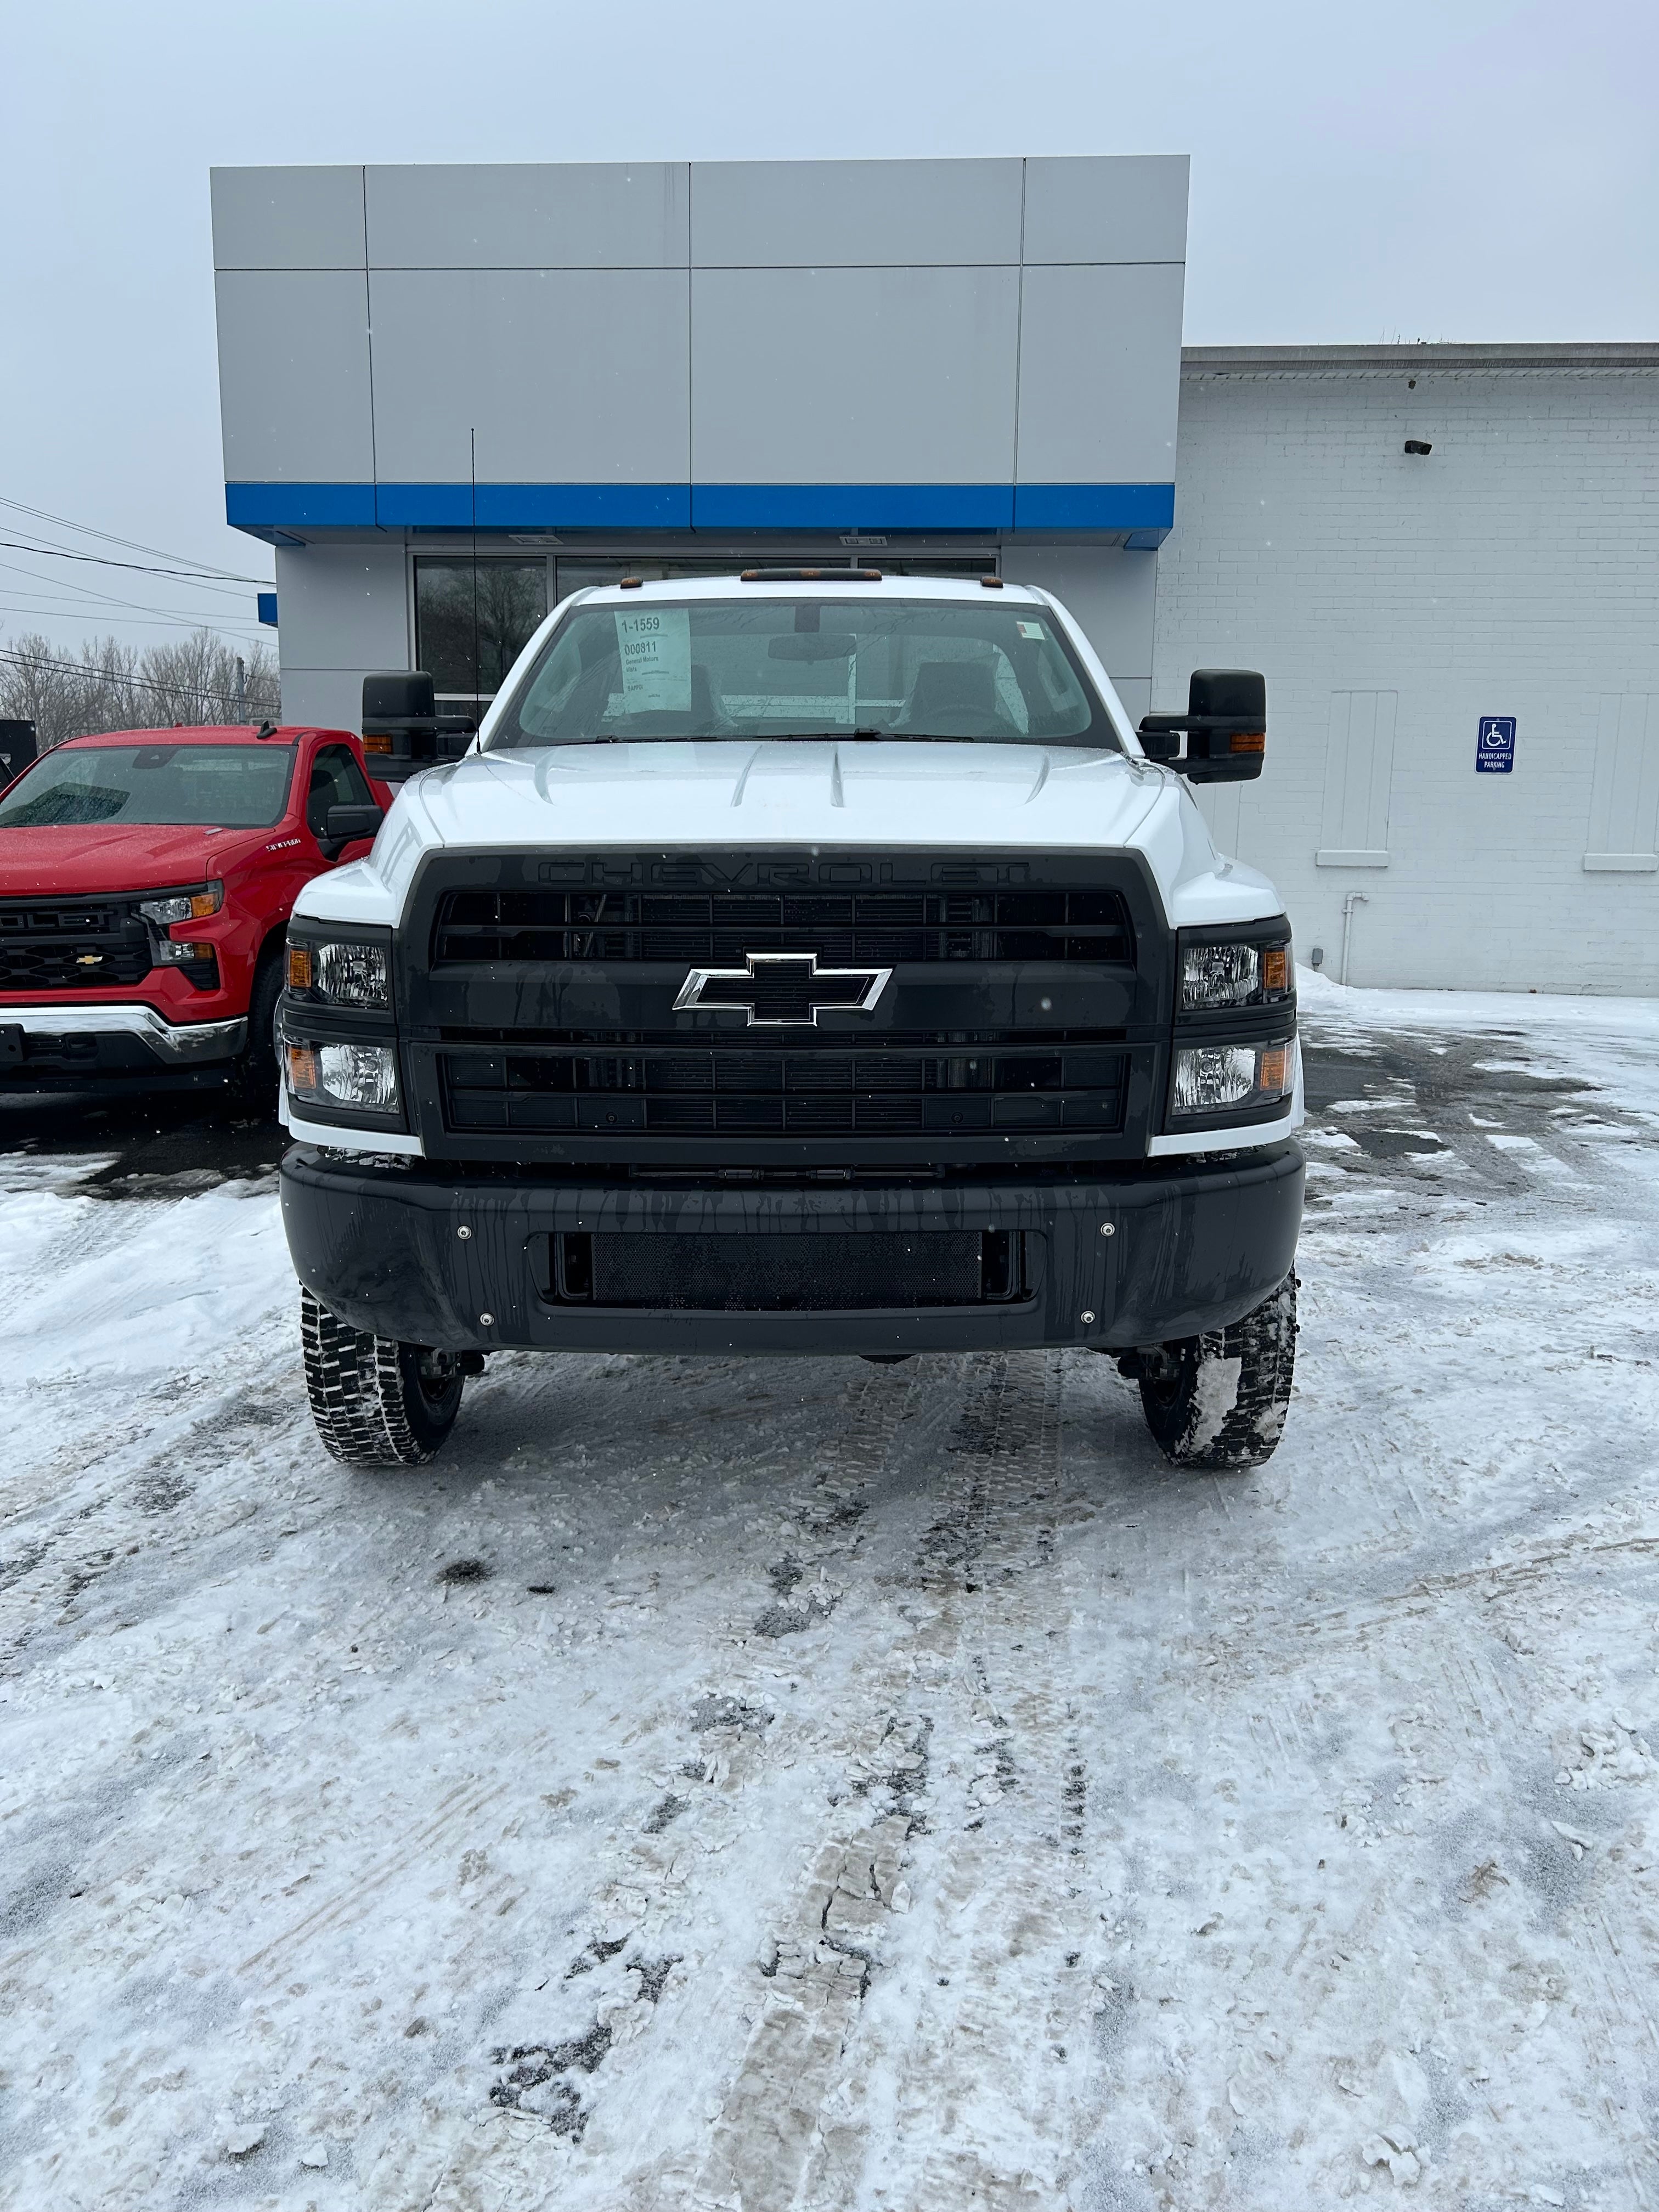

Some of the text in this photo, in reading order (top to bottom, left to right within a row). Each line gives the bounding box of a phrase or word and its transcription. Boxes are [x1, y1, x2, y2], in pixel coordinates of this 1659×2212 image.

[622, 617, 659, 633] 1-1559
[624, 641, 656, 656] 000811
[538, 862, 1030, 886] CHEVROLET
[0, 911, 115, 929] OLET
